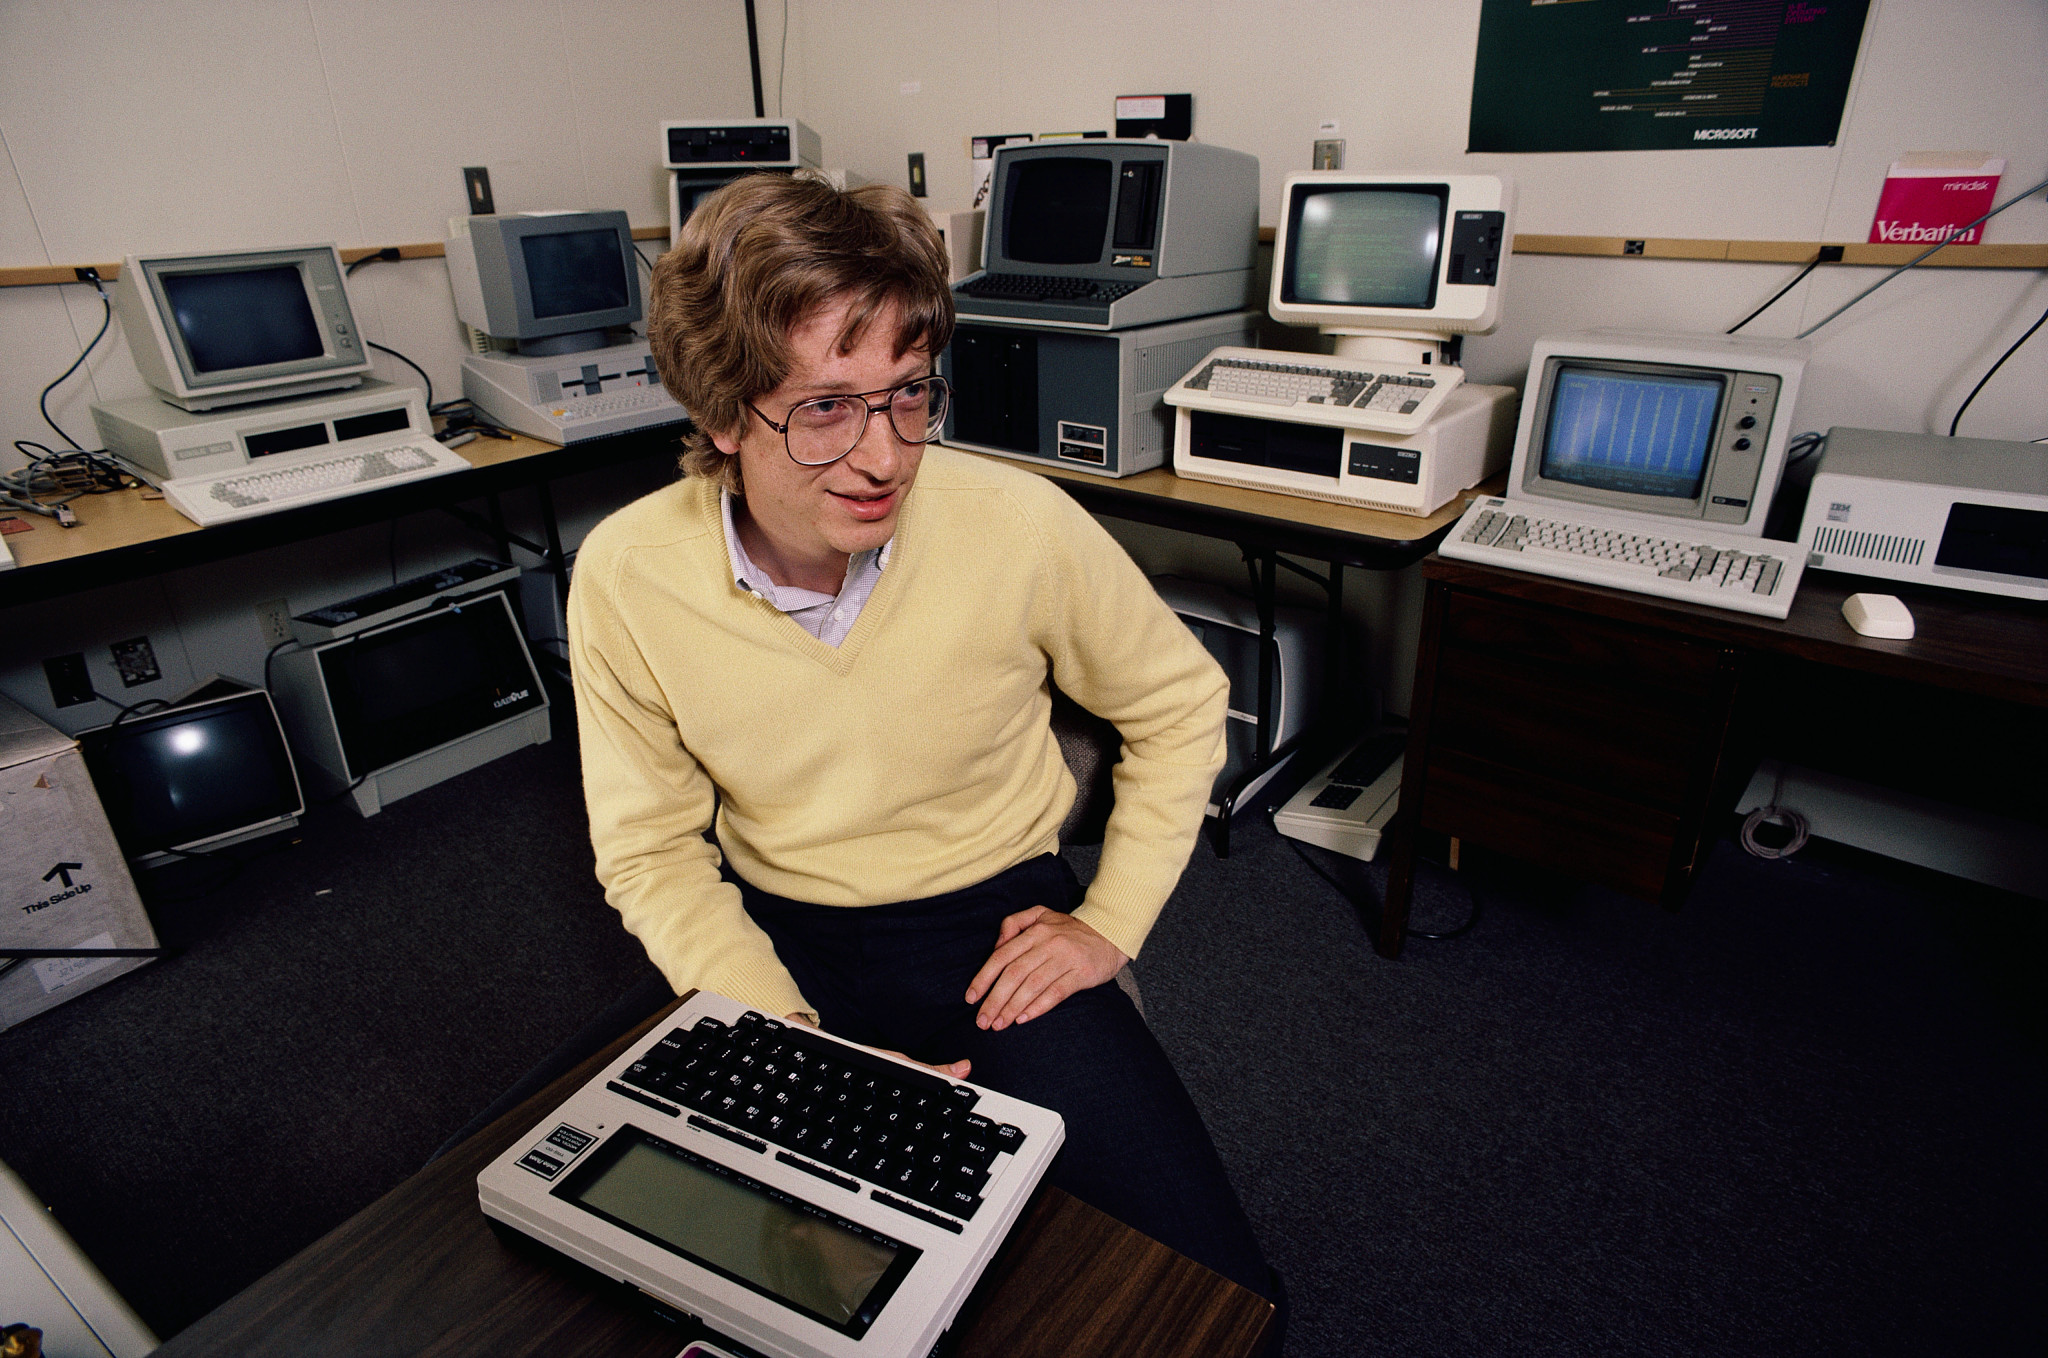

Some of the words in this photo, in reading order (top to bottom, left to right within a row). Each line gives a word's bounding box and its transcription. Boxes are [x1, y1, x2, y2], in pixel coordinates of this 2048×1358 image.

[1694, 127, 1759, 141] MICROSOFT
[1942, 180, 1990, 191] minidisk
[1877, 220, 1975, 242] Verbatim
[22, 900, 50, 915] This
[50, 890, 76, 905] Side
[75, 883, 92, 895] Up
[744, 1014, 758, 1022] NUM
[661, 1039, 681, 1049] ENTER
[966, 1117, 988, 1128] SHIFT
[998, 1129, 1014, 1138] CAPS
[1001, 1125, 1017, 1135] LOCK
[556, 1133, 582, 1147] PORTABLE
[559, 1129, 587, 1144] COMPUTER
[561, 1140, 579, 1150] MODEL
[968, 1141, 986, 1152] CTRL
[960, 1166, 975, 1176] TAB
[954, 1191, 972, 1203] ESC
